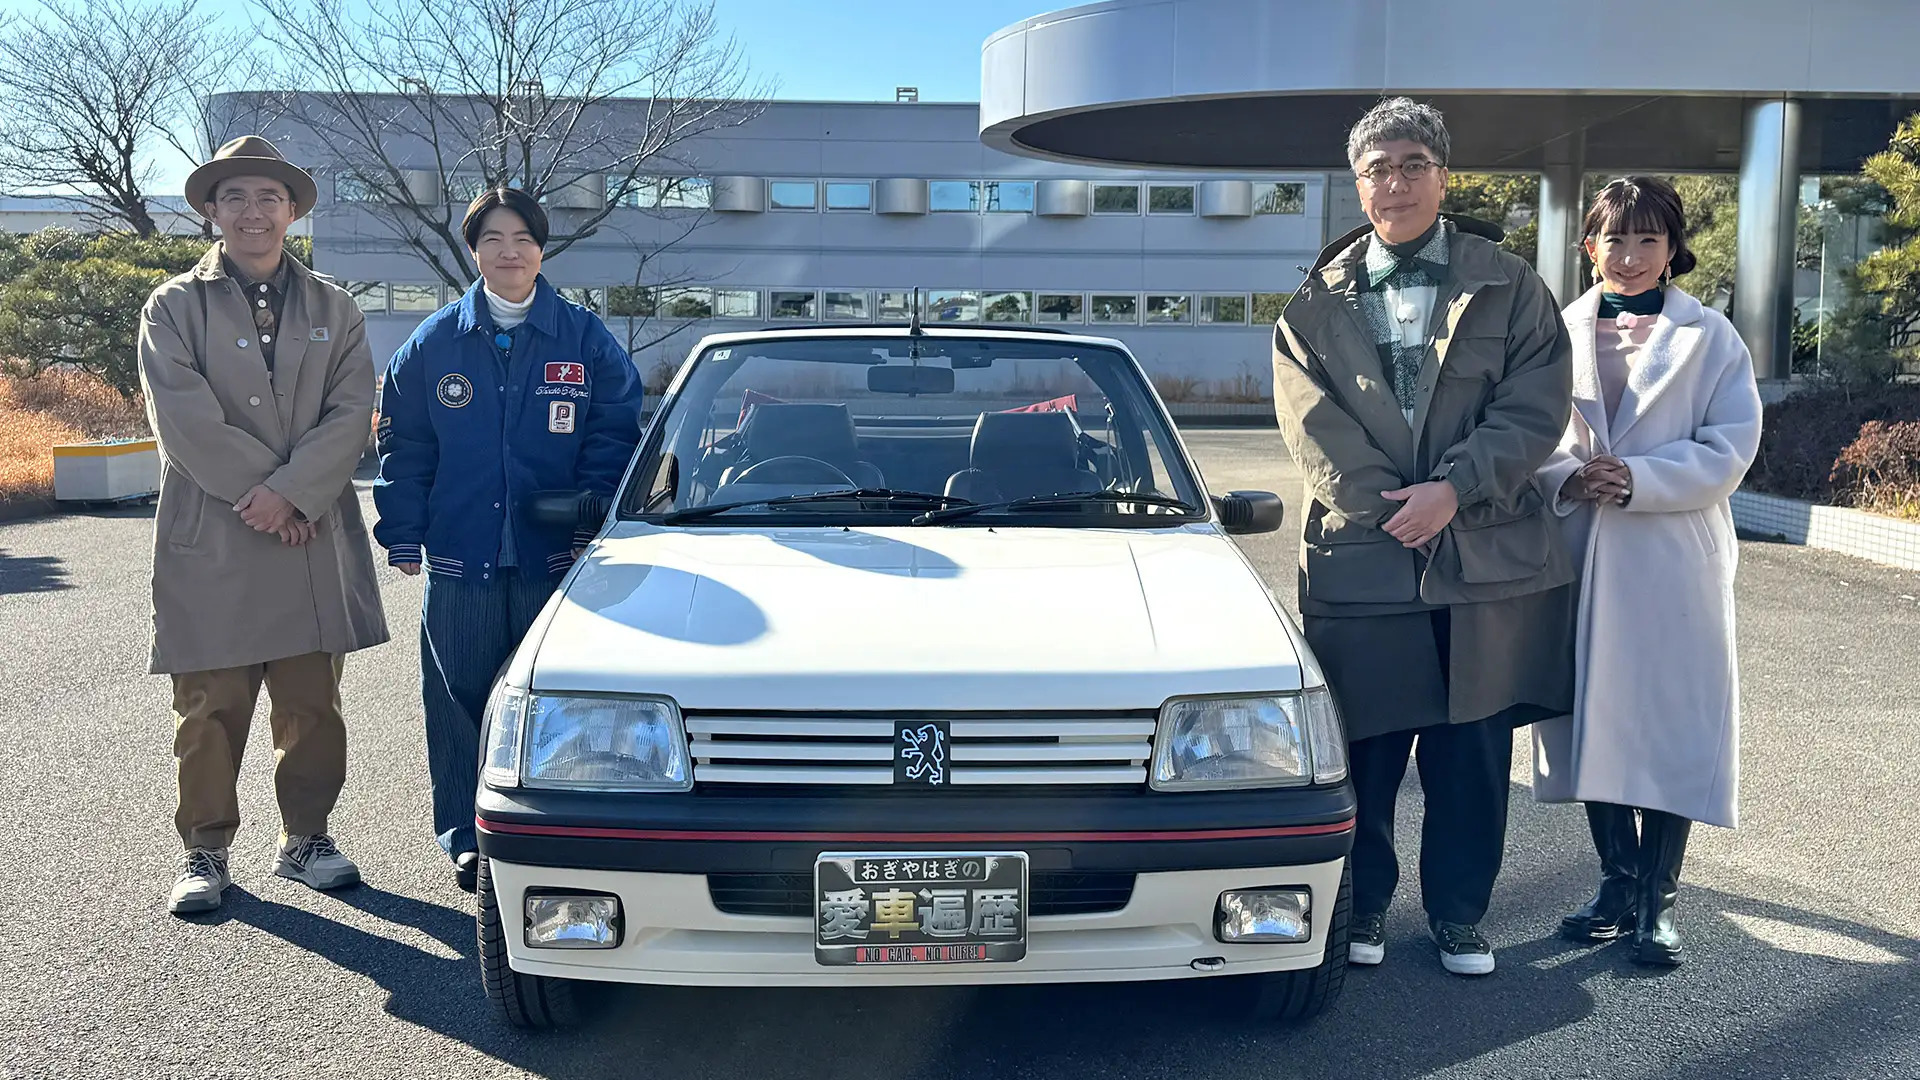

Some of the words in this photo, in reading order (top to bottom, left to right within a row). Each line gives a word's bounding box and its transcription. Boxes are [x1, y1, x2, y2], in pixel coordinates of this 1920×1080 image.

[861, 858, 980, 881] おぎやはぎの
[820, 887, 1020, 940] 愛車遍歴
[863, 947, 882, 962] NO
[924, 945, 942, 961] NO
